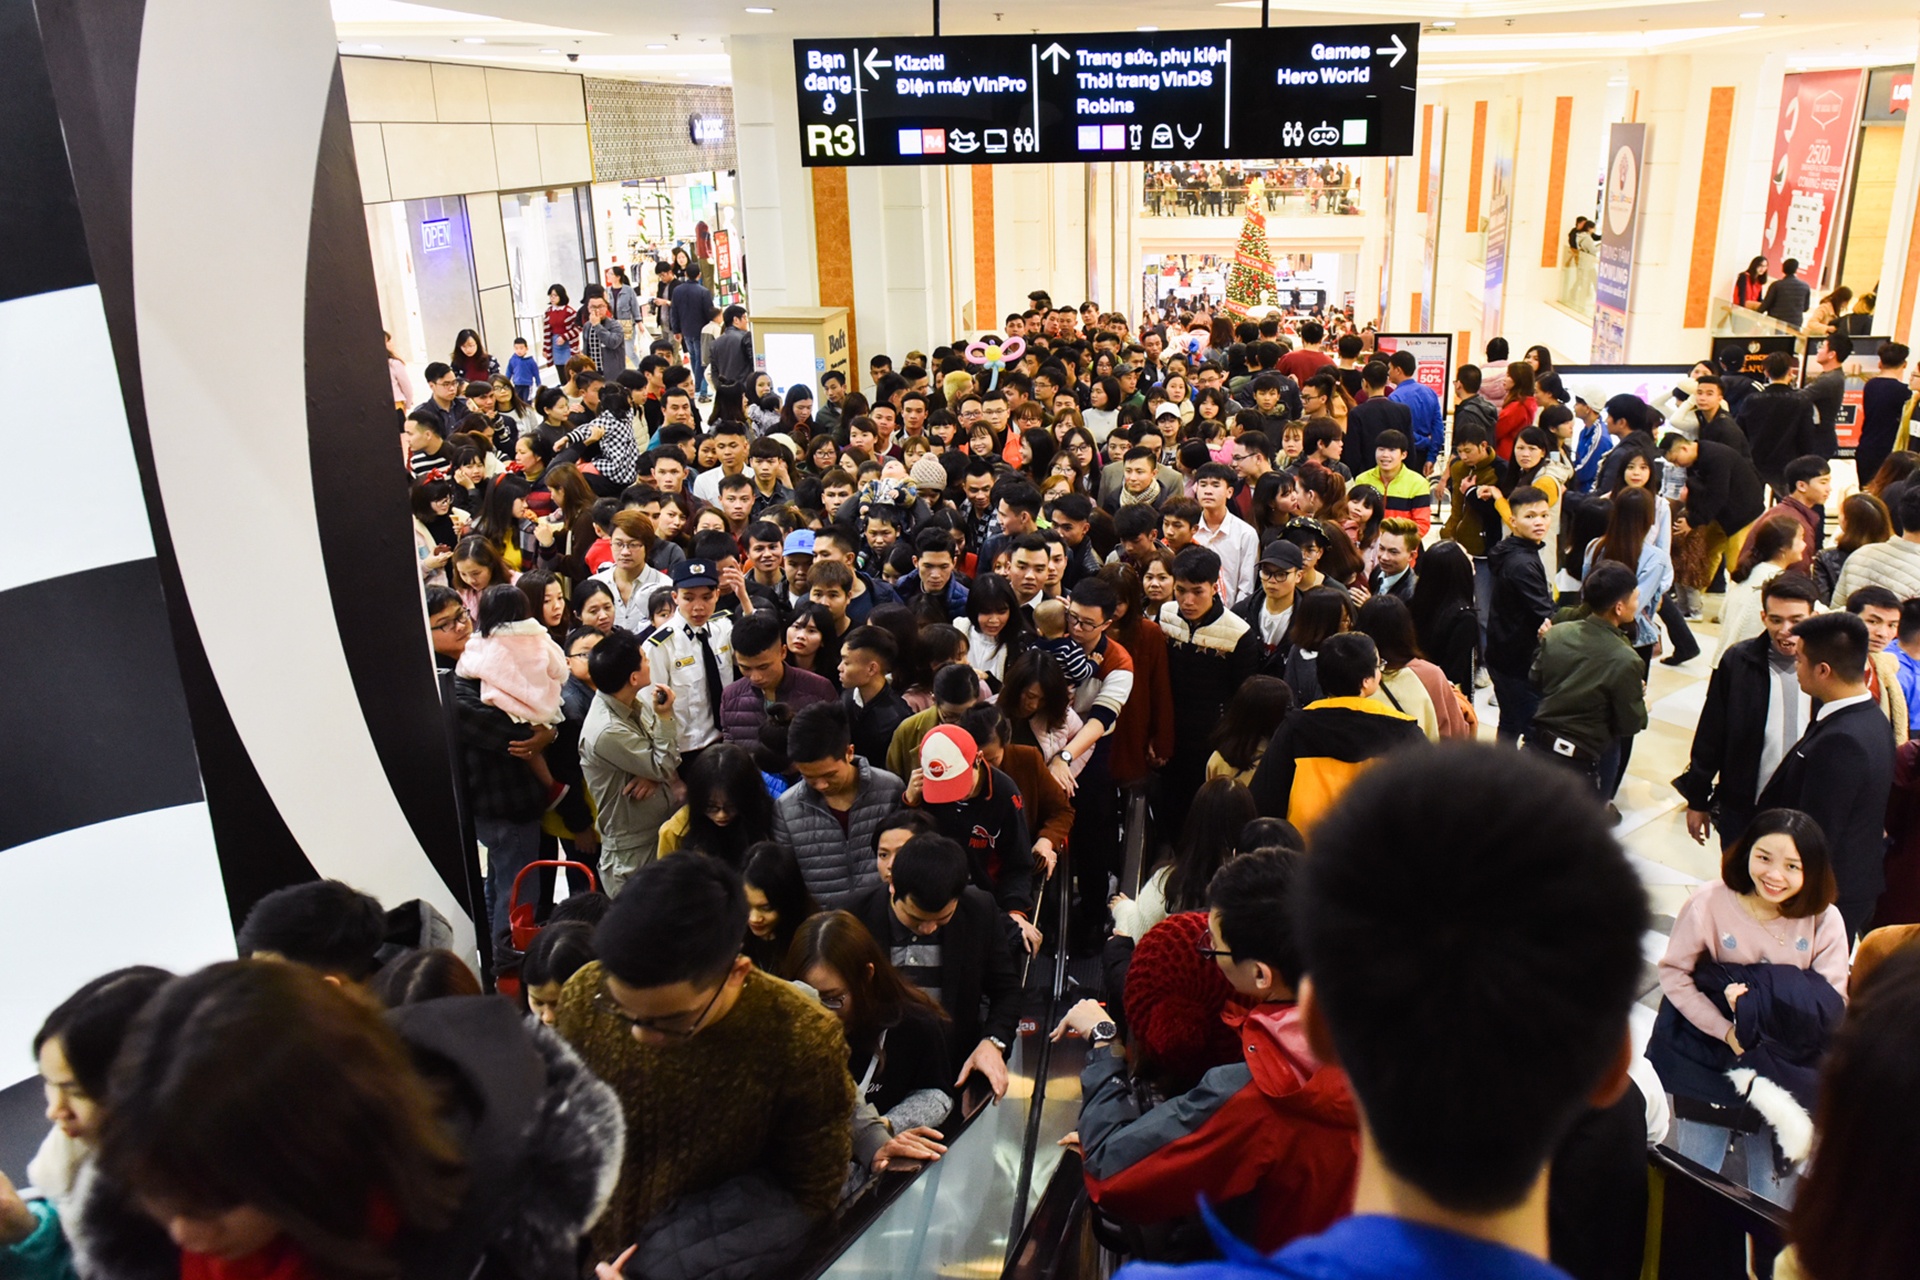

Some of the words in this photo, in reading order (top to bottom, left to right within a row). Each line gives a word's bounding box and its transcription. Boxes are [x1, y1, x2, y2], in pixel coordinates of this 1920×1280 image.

[807, 50, 846, 73] Bạn
[1076, 49, 1122, 69] Trang
[1124, 48, 1158, 67] sức,
[1160, 47, 1192, 67] phụ
[1194, 46, 1227, 67] kiện
[1311, 43, 1370, 60] Games
[804, 72, 852, 94] đang
[1076, 72, 1114, 89] Thời
[1115, 72, 1160, 91] trang
[1161, 69, 1213, 87] VinDS
[1277, 67, 1319, 85] Hero
[1320, 66, 1370, 84] World
[896, 77, 935, 98] Điện
[937, 76, 973, 96] máy
[972, 75, 1027, 93] VinPro
[823, 93, 837, 113] ở
[1077, 97, 1135, 114] Robins
[807, 124, 856, 156] R3
[924, 134, 943, 148] R4
[1805, 144, 1831, 165] 2500
[425, 224, 450, 249] OPEN
[1238, 255, 1263, 269] VINCOM
[1420, 374, 1442, 384] 50%
